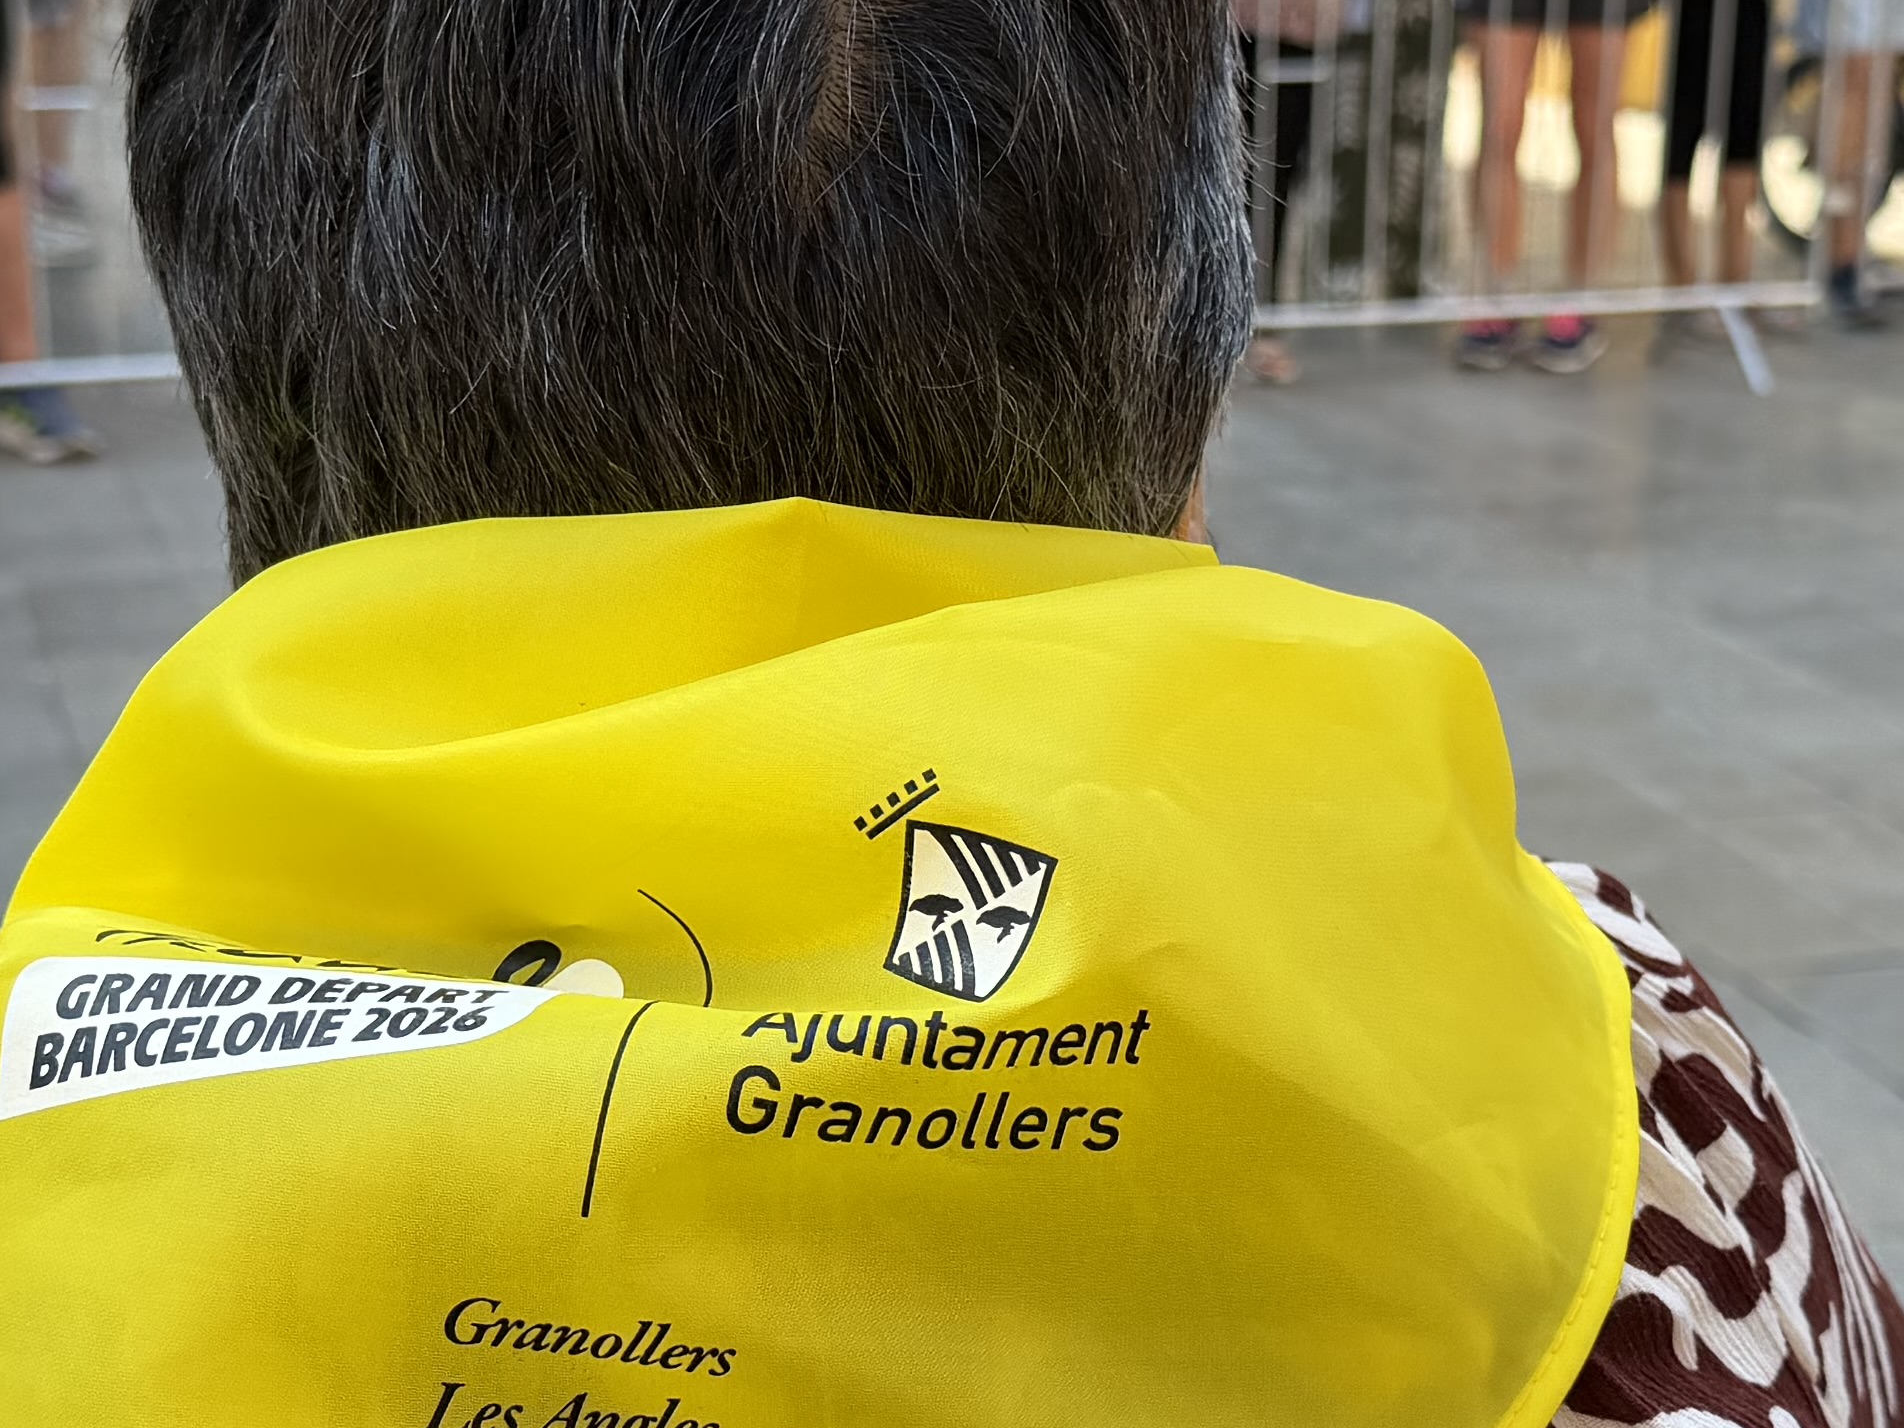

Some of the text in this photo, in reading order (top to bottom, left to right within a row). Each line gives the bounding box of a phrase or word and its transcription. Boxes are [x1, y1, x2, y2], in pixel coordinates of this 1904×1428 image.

[56, 974, 262, 1021] GRAND
[29, 1006, 494, 1091] BARCELONE 2026
[740, 1009, 1151, 1071] Ajuntament
[726, 1065, 1124, 1152] Granollers
[444, 1297, 737, 1377] Granollers
